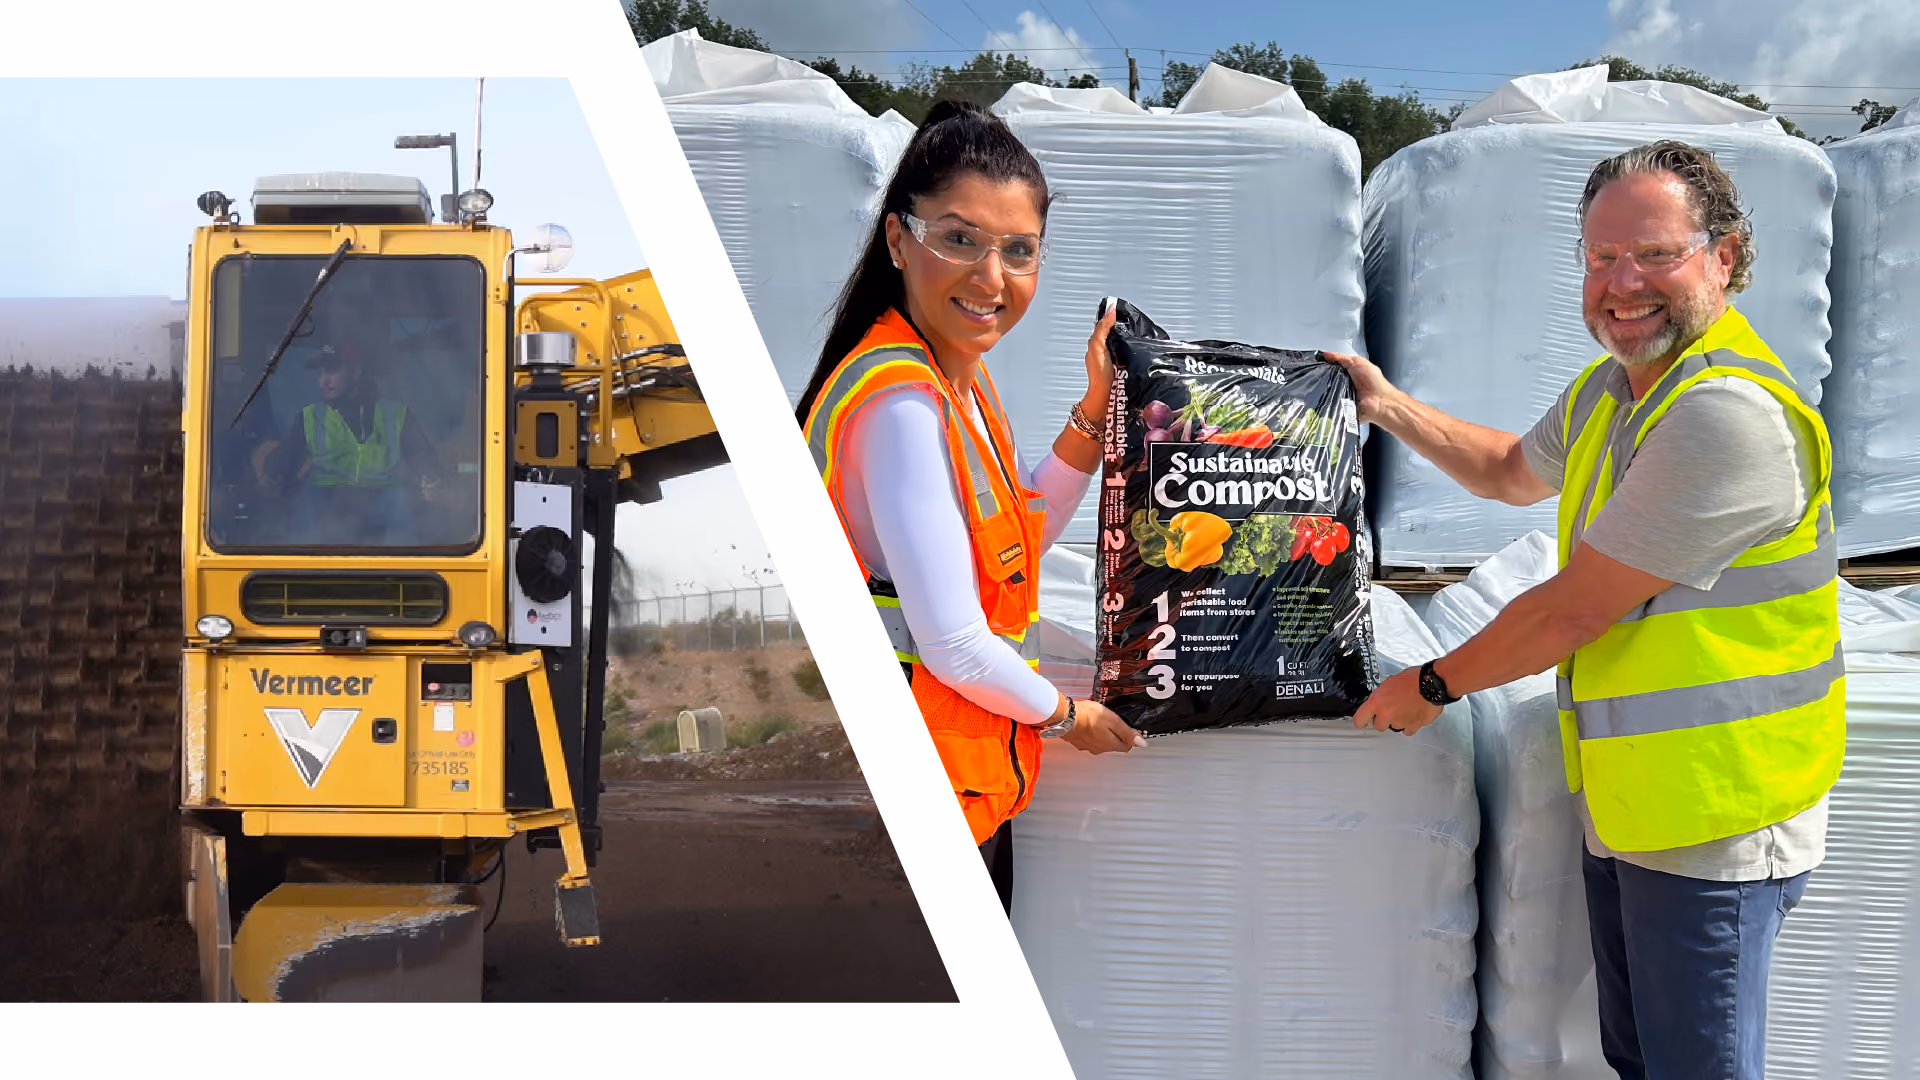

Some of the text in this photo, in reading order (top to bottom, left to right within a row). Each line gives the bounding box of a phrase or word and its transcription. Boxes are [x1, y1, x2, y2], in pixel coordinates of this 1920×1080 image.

[1105, 364, 1118, 463] ompost
[1117, 369, 1129, 457] Sustainable
[1105, 472, 1127, 487] 1
[1154, 471, 1333, 508] Compost
[1104, 528, 1126, 551] 2
[1103, 592, 1125, 613] 3
[1181, 588, 1226, 598] We collect
[1181, 598, 1226, 609] perishable
[1151, 590, 1169, 623] 1
[1180, 608, 1256, 617] items from stores
[1147, 624, 1177, 660] 2
[1181, 634, 1204, 642] Then
[1192, 644, 1231, 653] compost
[1276, 655, 1285, 676] 1
[1287, 662, 1299, 670] CU
[249, 667, 374, 696] Vermeer
[1146, 664, 1176, 699] 3
[1196, 684, 1213, 692] you
[1276, 682, 1325, 696] DENALI
[411, 761, 469, 776] 735185
